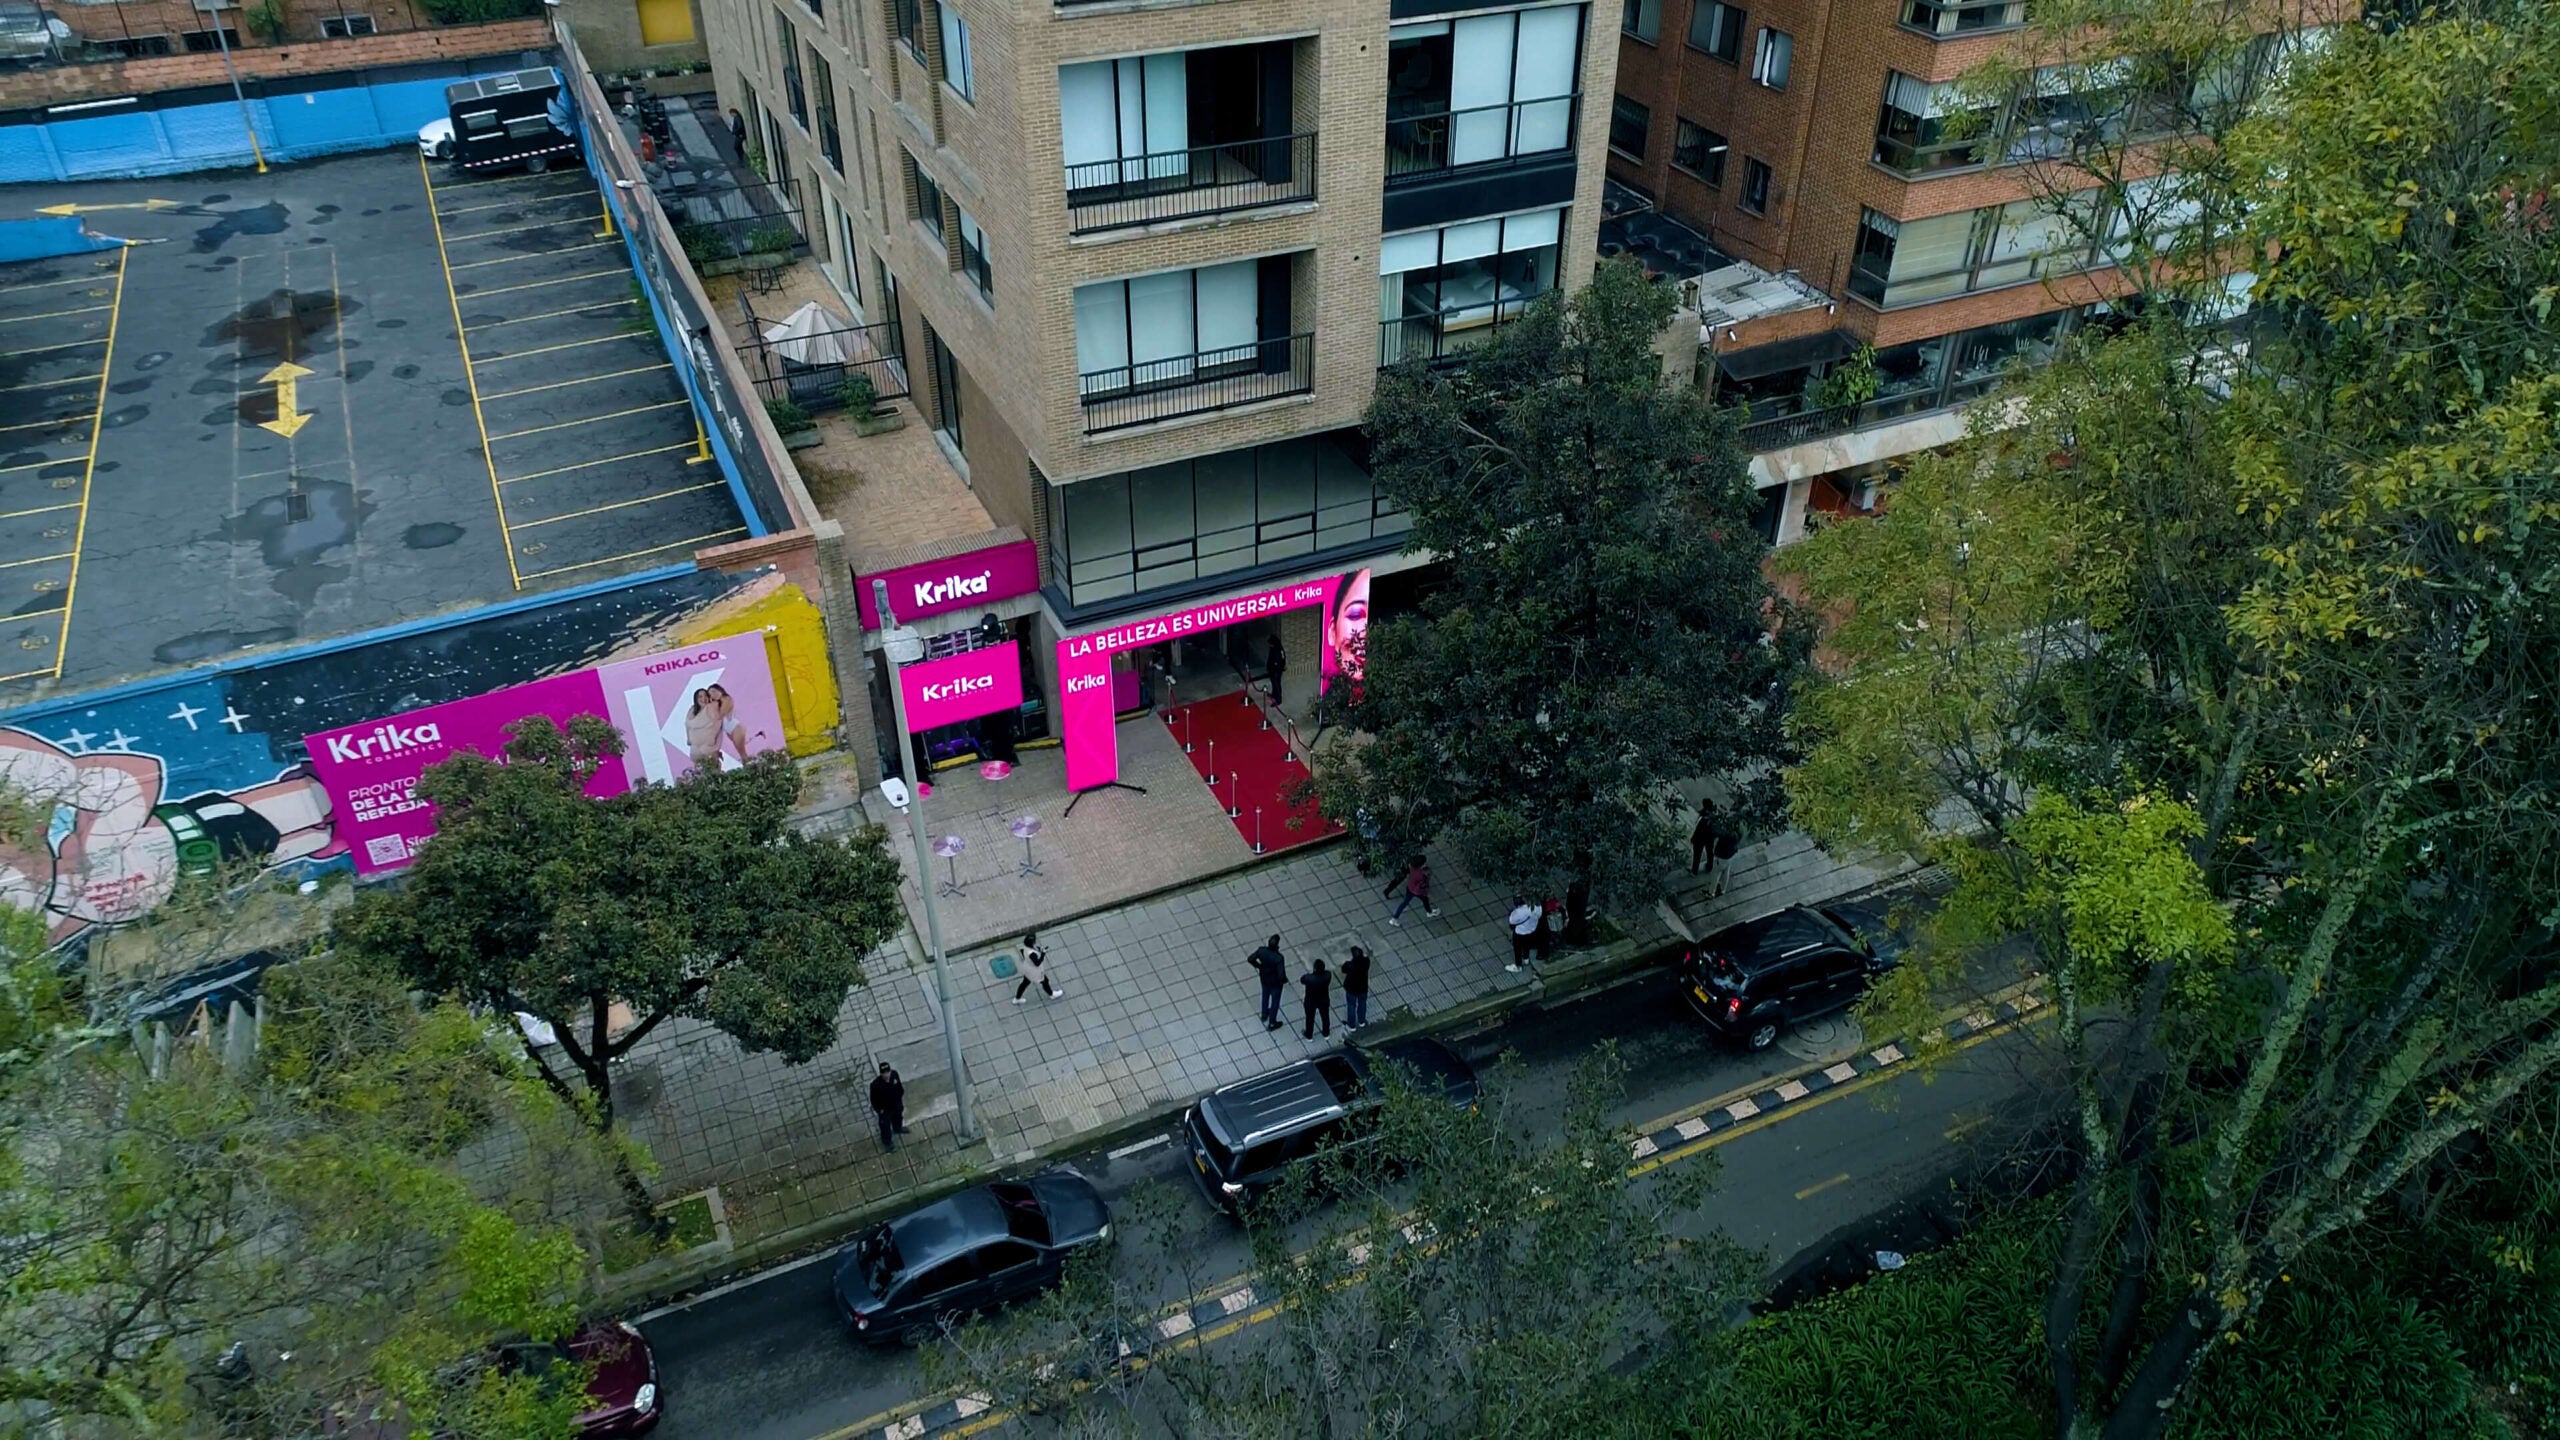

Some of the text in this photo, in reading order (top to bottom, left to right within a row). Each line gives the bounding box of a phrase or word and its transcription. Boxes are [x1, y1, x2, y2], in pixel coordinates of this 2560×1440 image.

[914, 570, 991, 607] Krika
[1294, 585, 1323, 602] Krika
[1070, 592, 1287, 658] LA BELLEZA ES UNIVERSAL
[644, 650, 720, 676] KRIKA.CO
[923, 674, 993, 702] Krika
[1067, 674, 1106, 693] Krika
[326, 723, 441, 764] Krika
[366, 742, 444, 765] COSMETICS
[348, 776, 417, 801] PRONTO
[351, 798, 377, 811] DE
[378, 792, 403, 805] LA
[355, 798, 430, 822] REFLEJA
